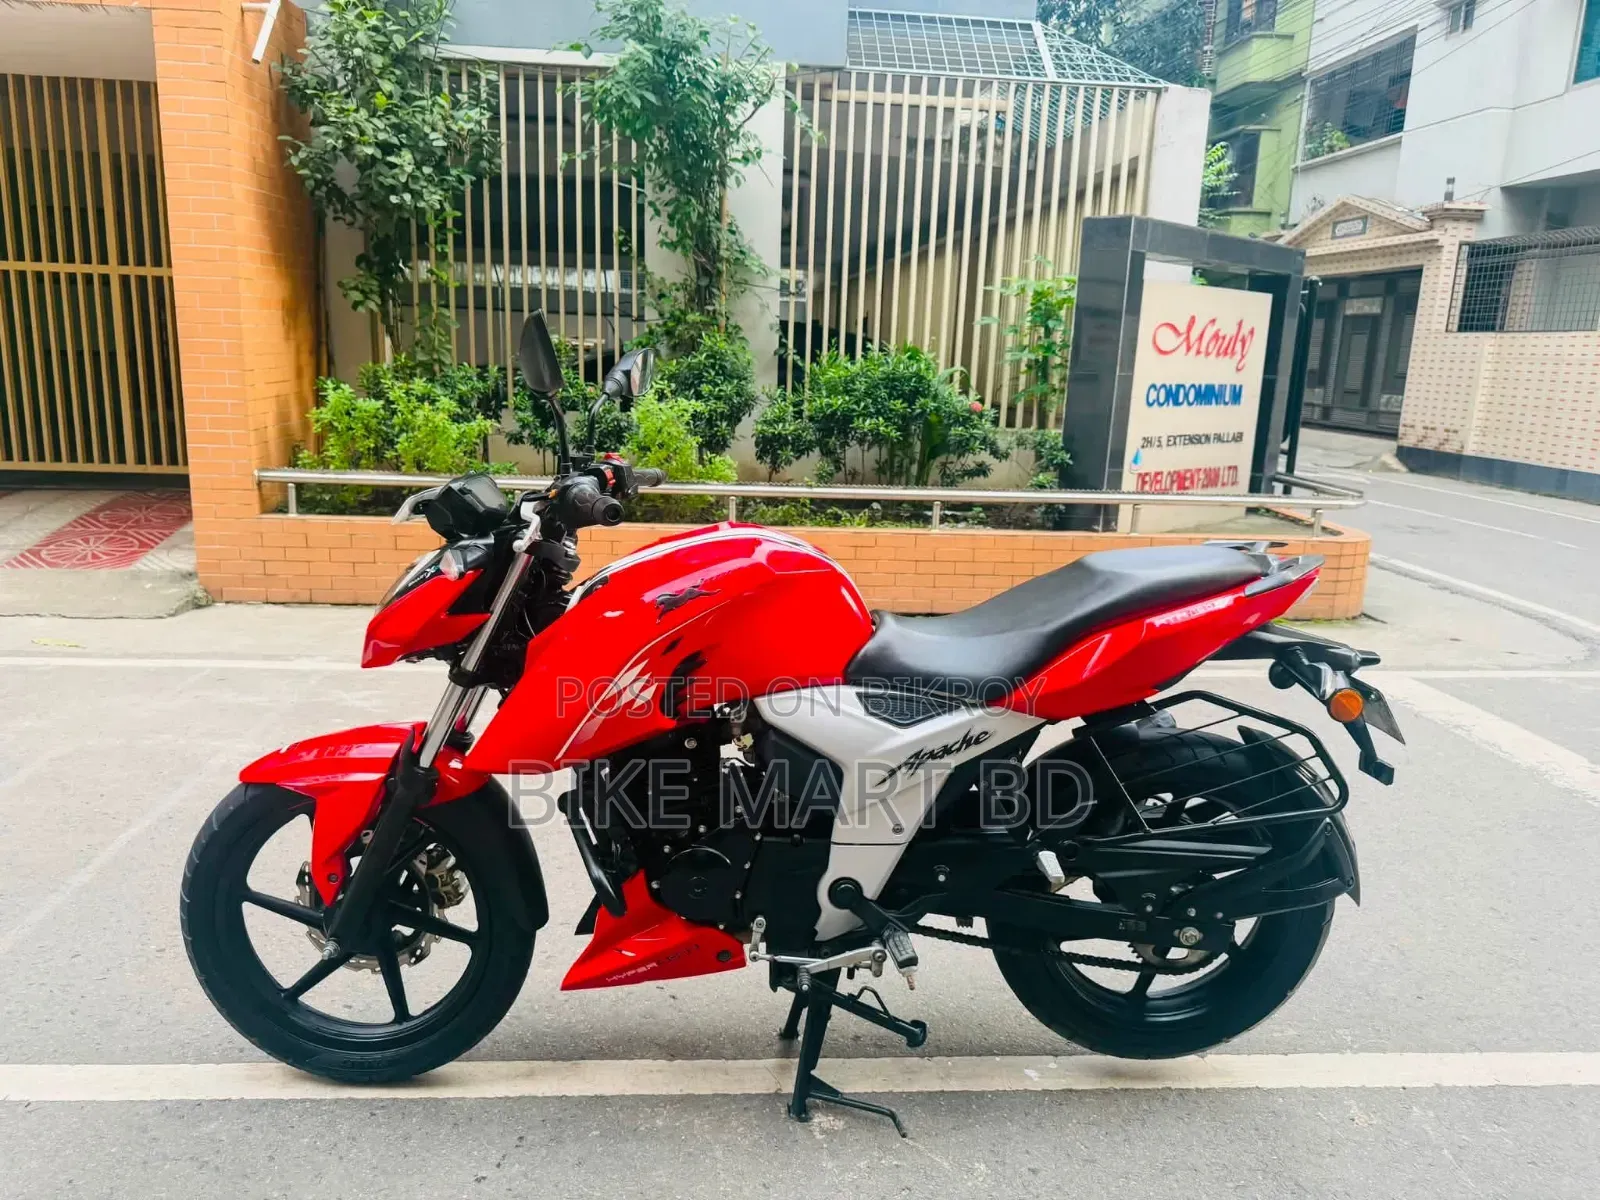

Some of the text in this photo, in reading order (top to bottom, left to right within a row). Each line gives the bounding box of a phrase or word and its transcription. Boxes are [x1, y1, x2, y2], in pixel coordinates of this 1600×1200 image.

[1152, 315, 1254, 372] Mouly
[1145, 383, 1243, 409] CONDOMINIUM
[1166, 433, 1211, 448] EXTENSION
[874, 725, 996, 787] Apache
